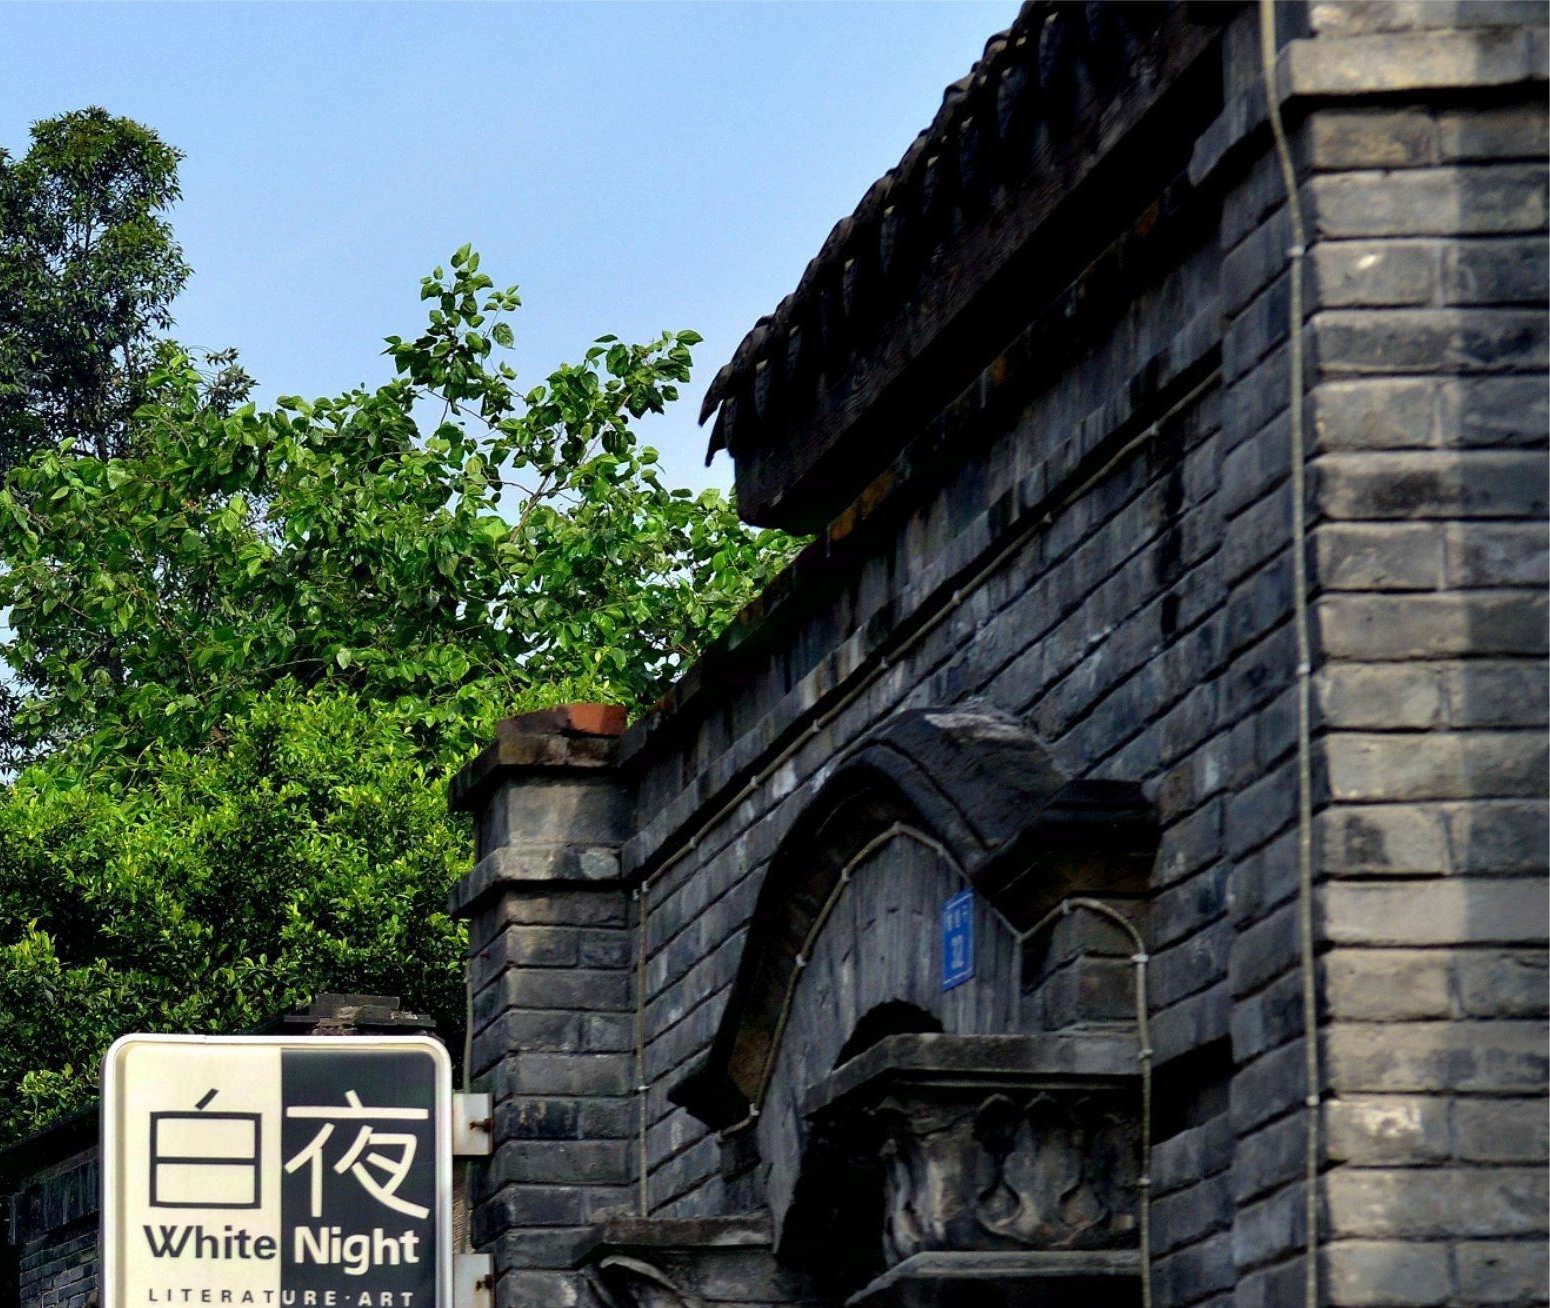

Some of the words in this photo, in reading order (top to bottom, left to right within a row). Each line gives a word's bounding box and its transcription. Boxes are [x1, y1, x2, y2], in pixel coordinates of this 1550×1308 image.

[148, 1088, 430, 1219] 白夜
[143, 1224, 277, 1260] White
[293, 1226, 420, 1275] Night
